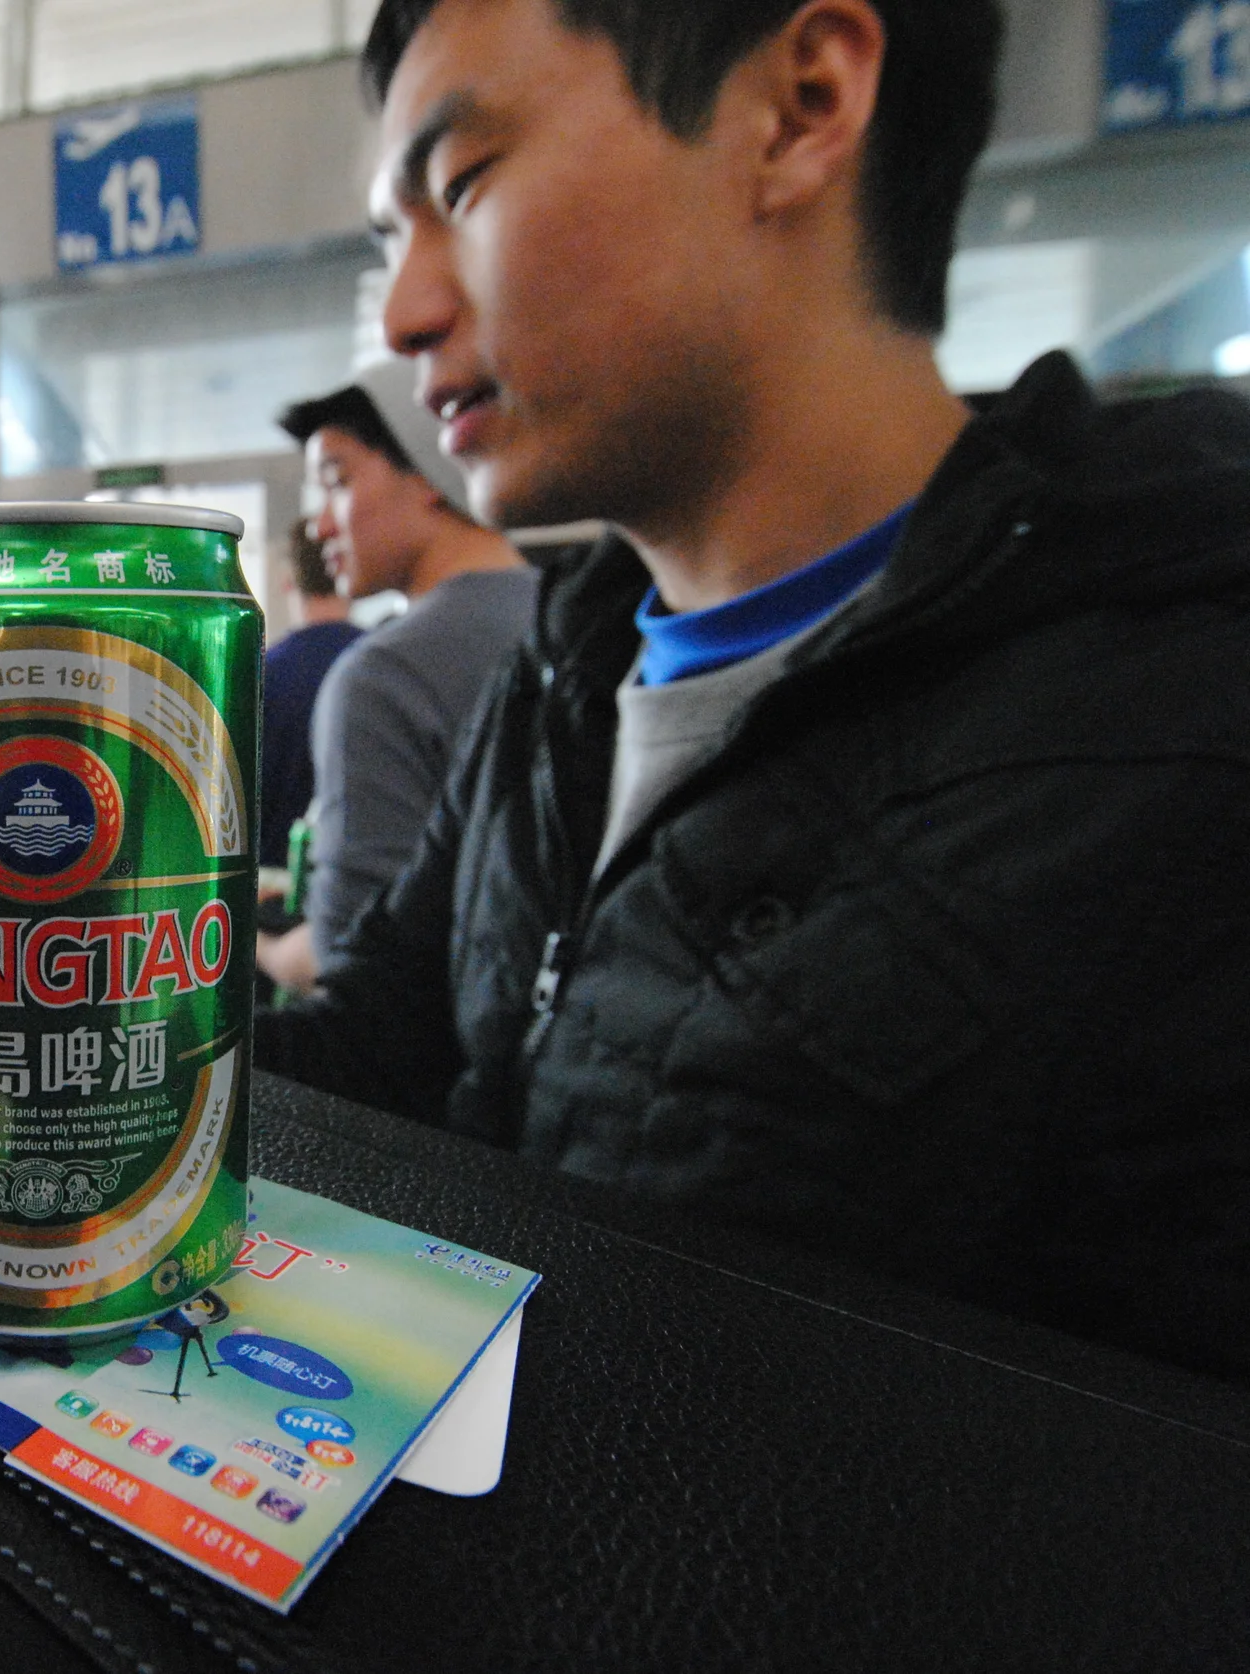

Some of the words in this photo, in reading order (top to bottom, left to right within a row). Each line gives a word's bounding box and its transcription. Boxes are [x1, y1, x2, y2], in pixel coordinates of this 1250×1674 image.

[55, 666, 117, 695] 1903
[3, 1123, 42, 1135] choose
[45, 1123, 70, 1137] only
[72, 1121, 91, 1134] the
[93, 1119, 117, 1134] high
[120, 1114, 155, 1130] quality
[156, 1108, 179, 1123] hops
[4, 1106, 37, 1118] brand
[40, 1108, 63, 1119] was
[66, 1101, 128, 1118] established
[131, 1099, 141, 1111] in
[4, 1140, 50, 1153] produce
[53, 1138, 75, 1151] this
[77, 1136, 112, 1150] award
[114, 1130, 155, 1147] winning
[111, 1096, 225, 1257] TRADEMARK
